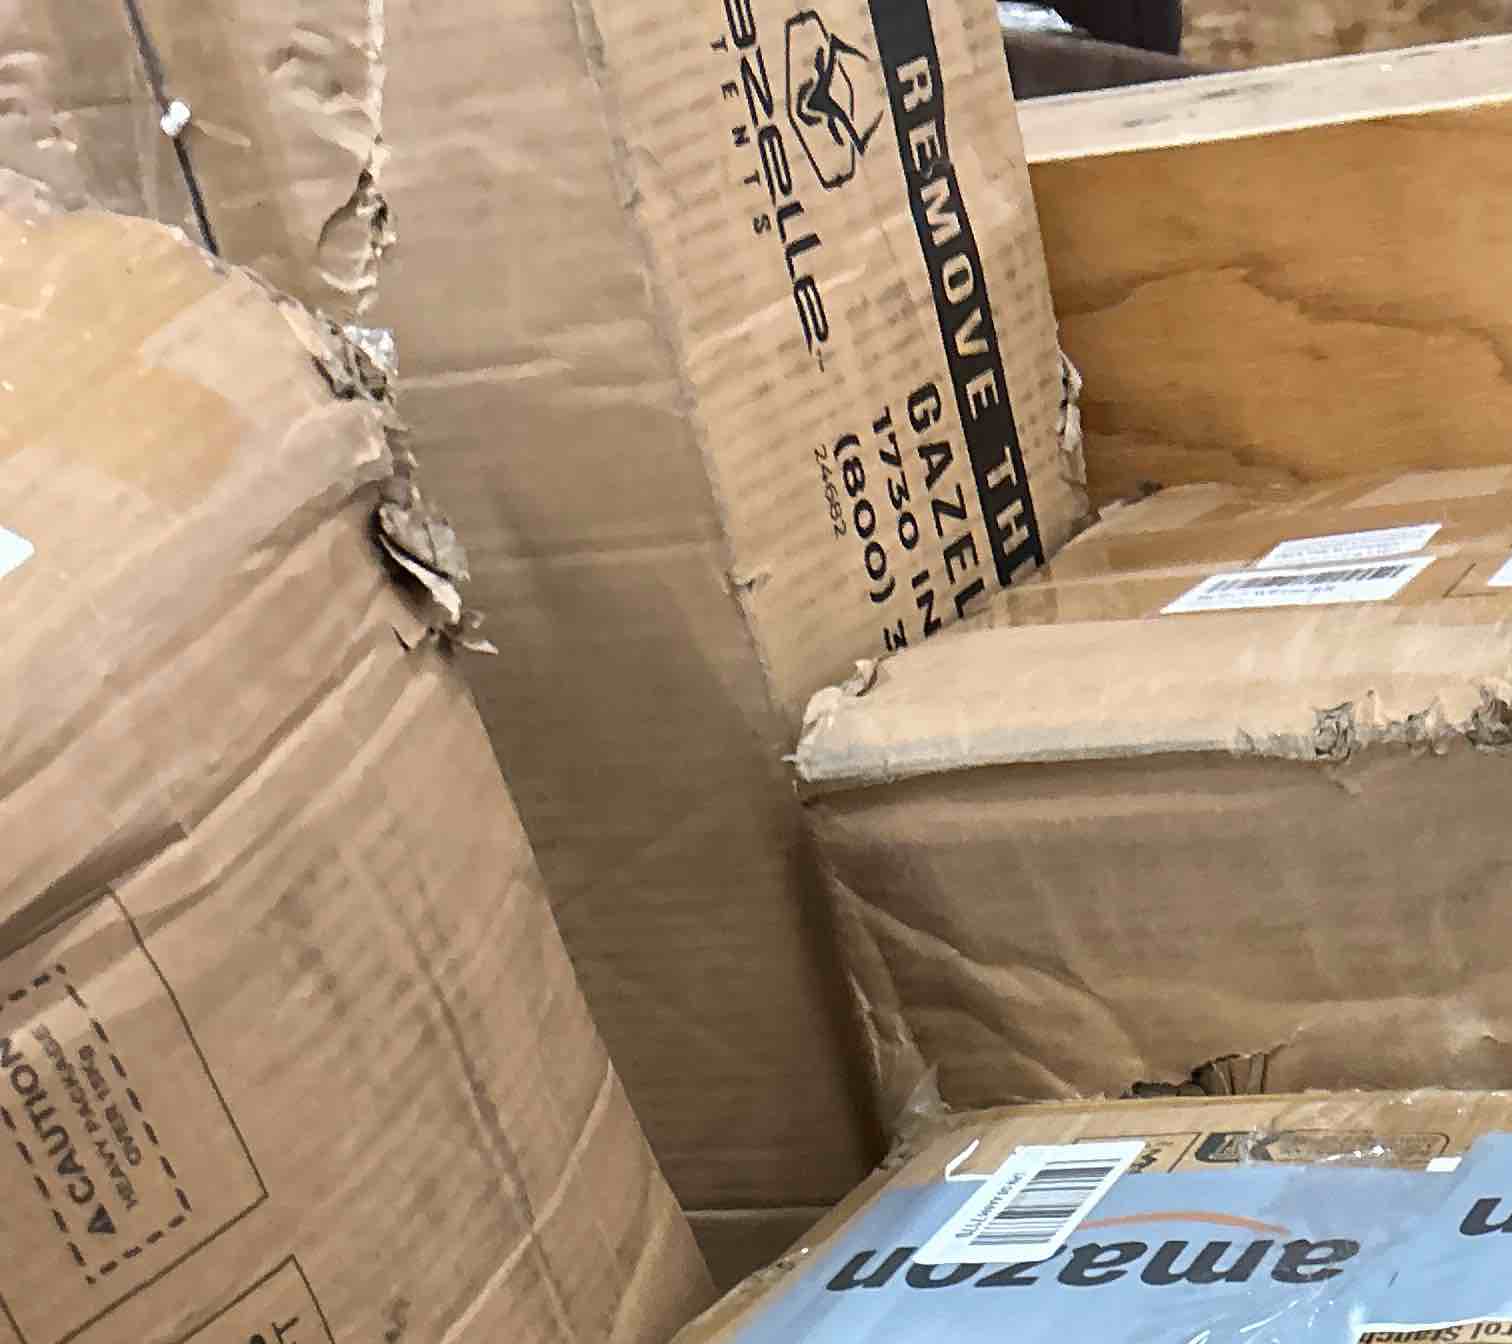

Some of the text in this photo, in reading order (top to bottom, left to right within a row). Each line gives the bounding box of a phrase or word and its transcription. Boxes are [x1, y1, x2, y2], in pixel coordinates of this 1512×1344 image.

[710, 34, 771, 235] TENTS
[896, 55, 1035, 570] REMOVE TH
[833, 434, 896, 603] (800)
[872, 405, 919, 550] 1730
[0, 1037, 96, 1204] CAUTION
[825, 1237, 1362, 1292] amazon
